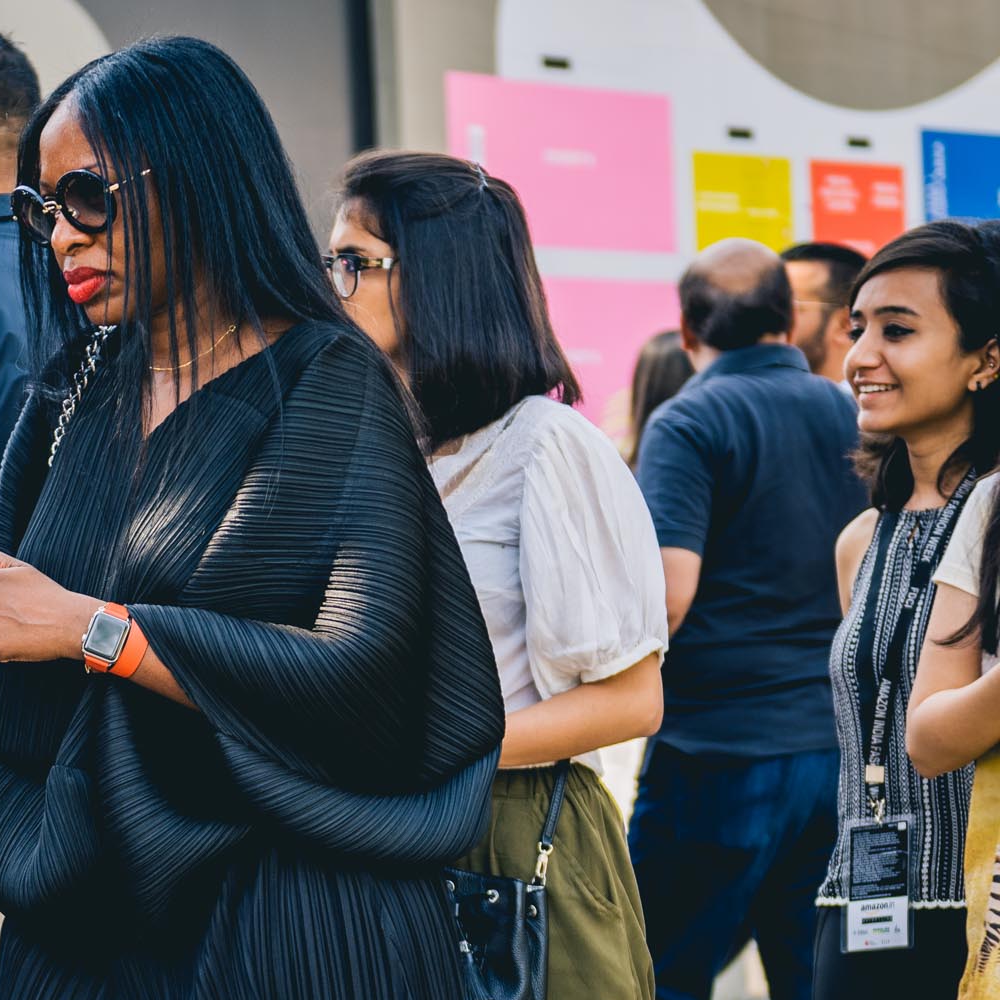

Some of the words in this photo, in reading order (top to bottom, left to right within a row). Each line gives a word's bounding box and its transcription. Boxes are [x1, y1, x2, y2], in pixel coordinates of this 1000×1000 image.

[932, 499, 960, 536] FASHION
[920, 536, 941, 562] WEEK
[903, 586, 920, 608] FDCI
[874, 677, 892, 719] AMAZON
[870, 719, 886, 745] INDIA
